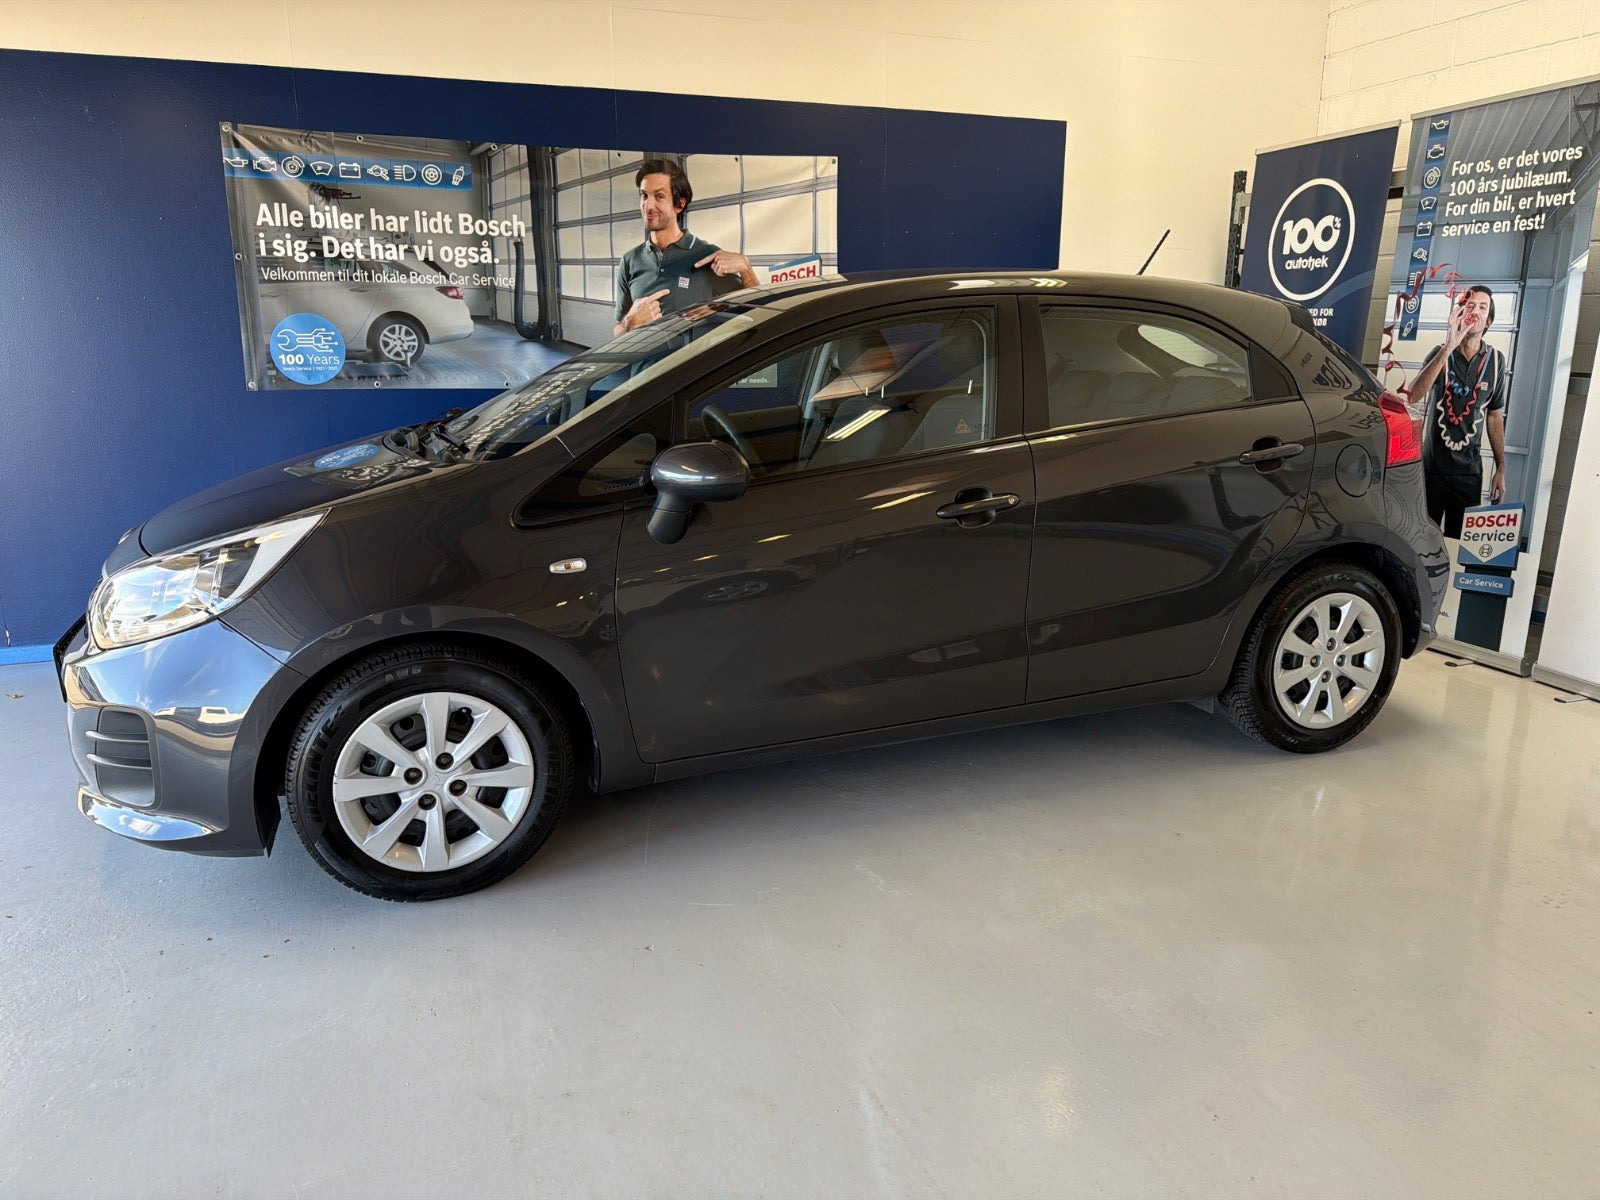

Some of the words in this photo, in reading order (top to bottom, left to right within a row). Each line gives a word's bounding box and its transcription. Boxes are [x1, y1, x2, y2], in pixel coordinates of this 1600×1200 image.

[1451, 161, 1474, 176] For
[1475, 159, 1495, 174] os,
[1497, 155, 1514, 170] er
[1516, 149, 1540, 168] det
[1542, 145, 1584, 163] vores
[1448, 179, 1476, 197] 100
[1477, 176, 1498, 194] års
[1499, 170, 1572, 194] jubilæum.
[1445, 201, 1468, 217] For
[1469, 197, 1491, 215] din
[1492, 194, 1516, 214] bil,
[1518, 196, 1534, 211] er
[1536, 189, 1577, 209] hvert
[256, 202, 304, 228] Alle
[309, 204, 364, 230] biler
[369, 207, 409, 232] har
[414, 210, 453, 235] lidt
[458, 213, 526, 238] Bosch
[1441, 219, 1490, 237] service
[1492, 219, 1511, 233] en
[1513, 213, 1547, 232] fest!
[258, 232, 267, 257] i
[272, 233, 316, 263] sig.
[321, 235, 366, 259] Det
[368, 236, 409, 261] har
[413, 239, 434, 262] vi
[439, 240, 500, 269] også.
[1285, 254, 1329, 271] autotjek
[260, 266, 335, 281] Velkommen
[337, 268, 350, 282] til
[352, 268, 369, 283] dit
[371, 269, 408, 284] lokale
[409, 271, 447, 285] Bosch
[448, 272, 470, 285] Car
[472, 272, 516, 287] Service
[770, 265, 816, 284] BOSCH
[1319, 307, 1334, 317] FOR
[279, 353, 304, 365] 100
[306, 353, 340, 365] Years
[1465, 513, 1518, 529] BOSCH
[1463, 529, 1515, 542] Service
[1459, 577, 1473, 585] Car
[1474, 578, 1504, 589] Service
